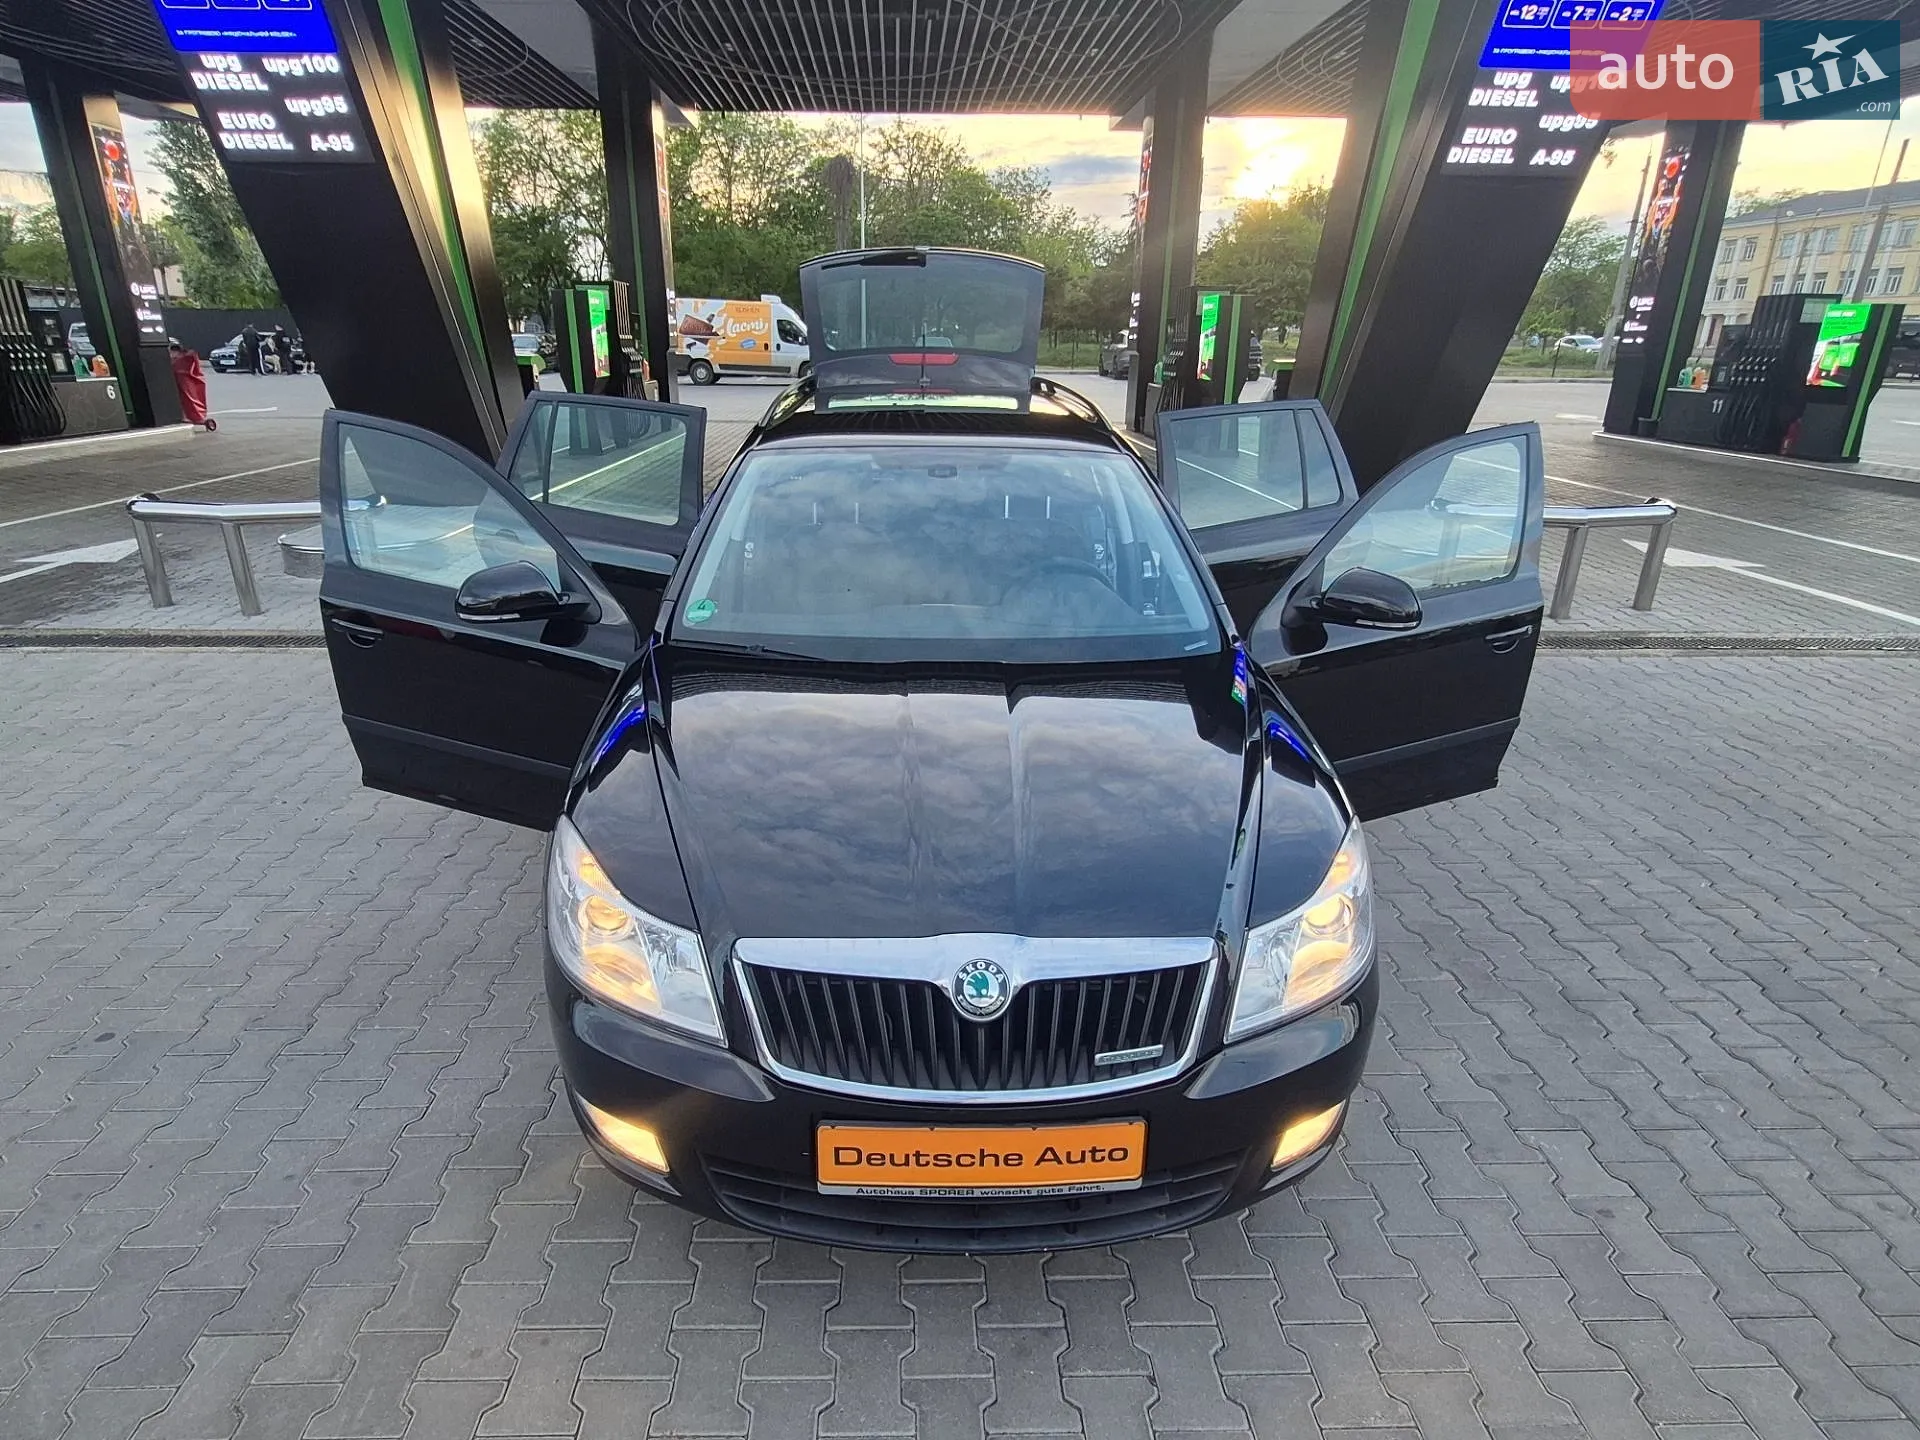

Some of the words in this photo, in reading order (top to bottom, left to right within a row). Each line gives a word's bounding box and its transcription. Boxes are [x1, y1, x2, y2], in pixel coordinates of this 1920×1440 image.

[200, 54, 242, 73] upg
[262, 55, 340, 76] upg100
[190, 72, 269, 91] DIESEL
[1493, 72, 1533, 89] upg
[284, 95, 348, 117] upg95
[1468, 88, 1539, 107] DIESEL
[217, 112, 276, 130] EURO
[218, 132, 294, 150] DIESEL
[310, 133, 355, 152] A-95
[1461, 128, 1517, 144] EURO
[1446, 147, 1514, 164] DIESEL
[1529, 149, 1576, 166] A-95
[107, 385, 116, 400] 6
[1712, 399, 1724, 414] 11
[697, 600, 706, 610] 4
[833, 1146, 1024, 1168] Deutsche
[1034, 1146, 1129, 1167] Auto
[856, 1187, 914, 1196] Autohaus
[1037, 1187, 1064, 1197] gute
[1068, 1184, 1105, 1193] Fahrt.
